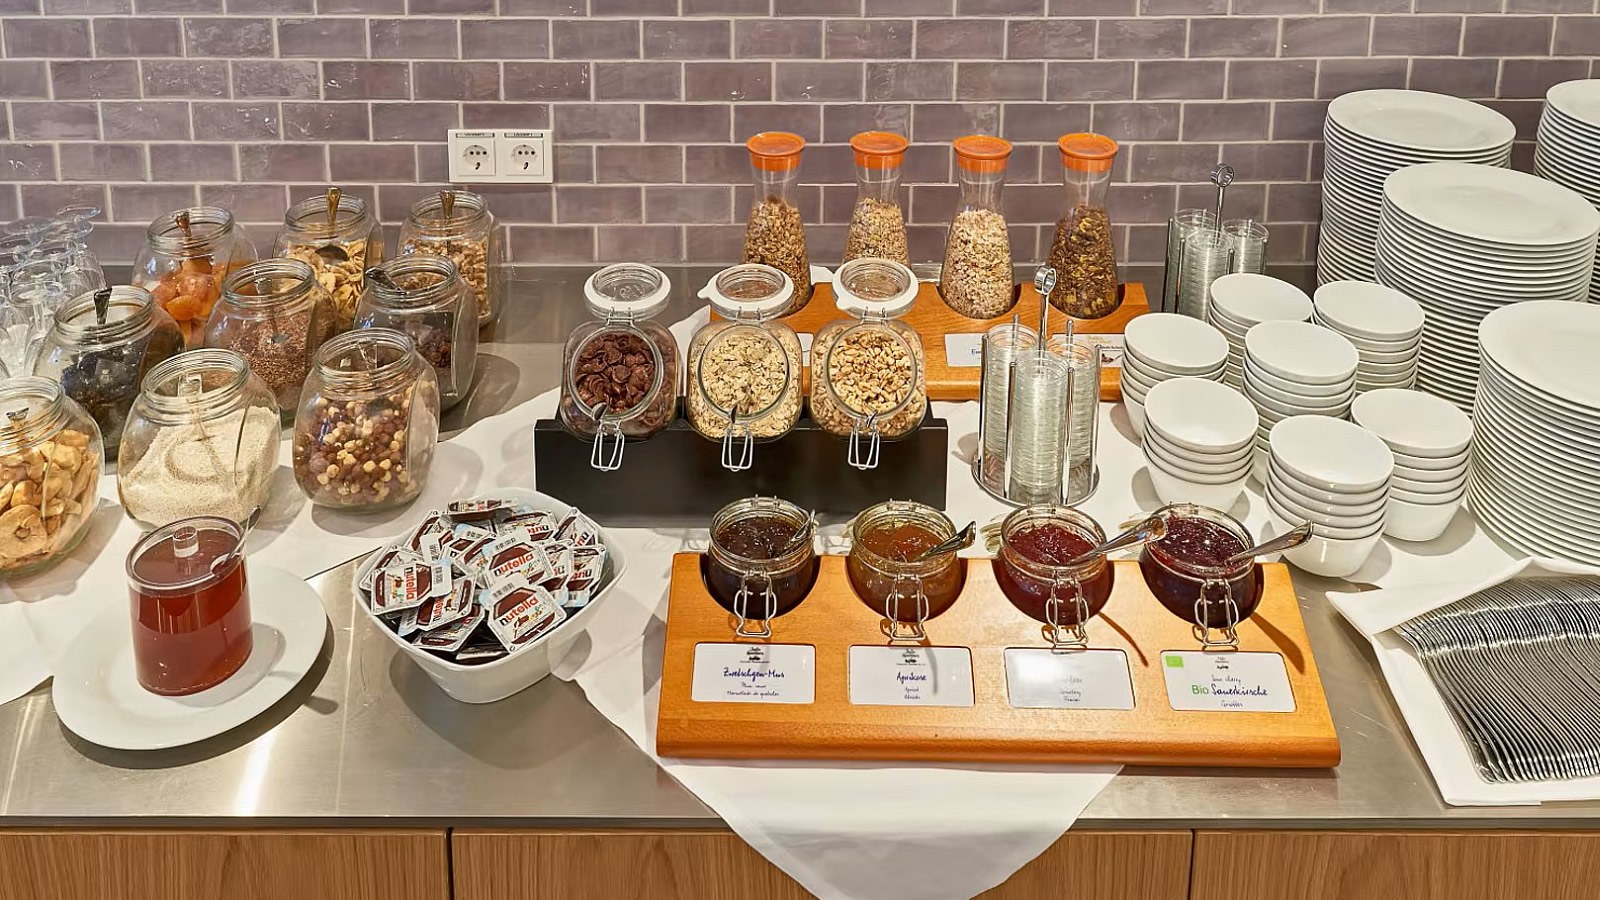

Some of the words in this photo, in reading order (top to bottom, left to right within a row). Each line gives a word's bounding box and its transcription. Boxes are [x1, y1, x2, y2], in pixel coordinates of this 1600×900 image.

[526, 524, 550, 534] nut
[493, 552, 535, 577] nutella
[403, 566, 416, 601] nutella
[499, 595, 540, 627] nutella
[1191, 684, 1209, 695] Bio
